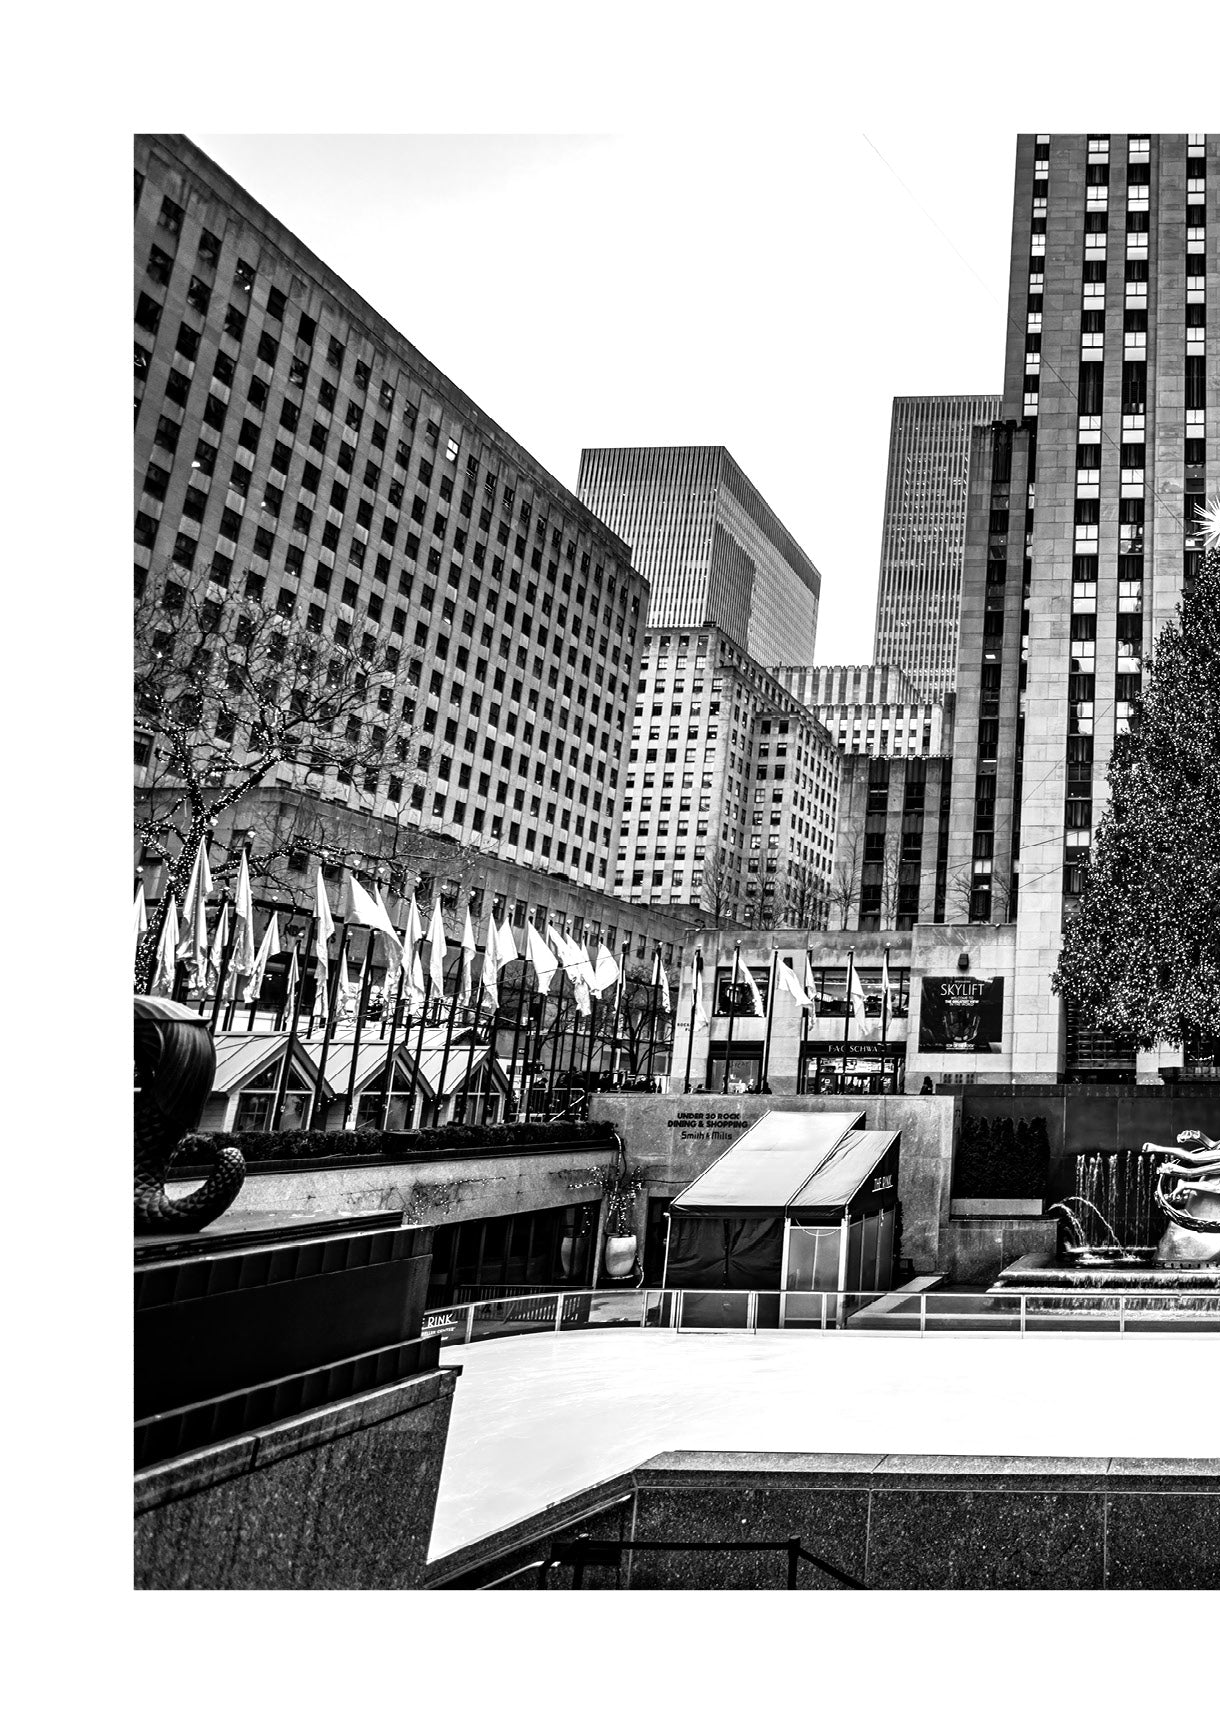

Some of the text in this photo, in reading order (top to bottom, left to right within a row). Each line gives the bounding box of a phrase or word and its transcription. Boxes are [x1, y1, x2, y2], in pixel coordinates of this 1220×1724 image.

[940, 983, 985, 996] SKYLIFT
[849, 1044, 884, 1053] SCHWA
[677, 1112, 740, 1120] UNDER 30 ROCK
[667, 1120, 748, 1129] DINING & SHOPPING
[681, 1131, 704, 1140] Smith
[712, 1131, 732, 1140] Mills
[427, 1313, 454, 1329] RINK
